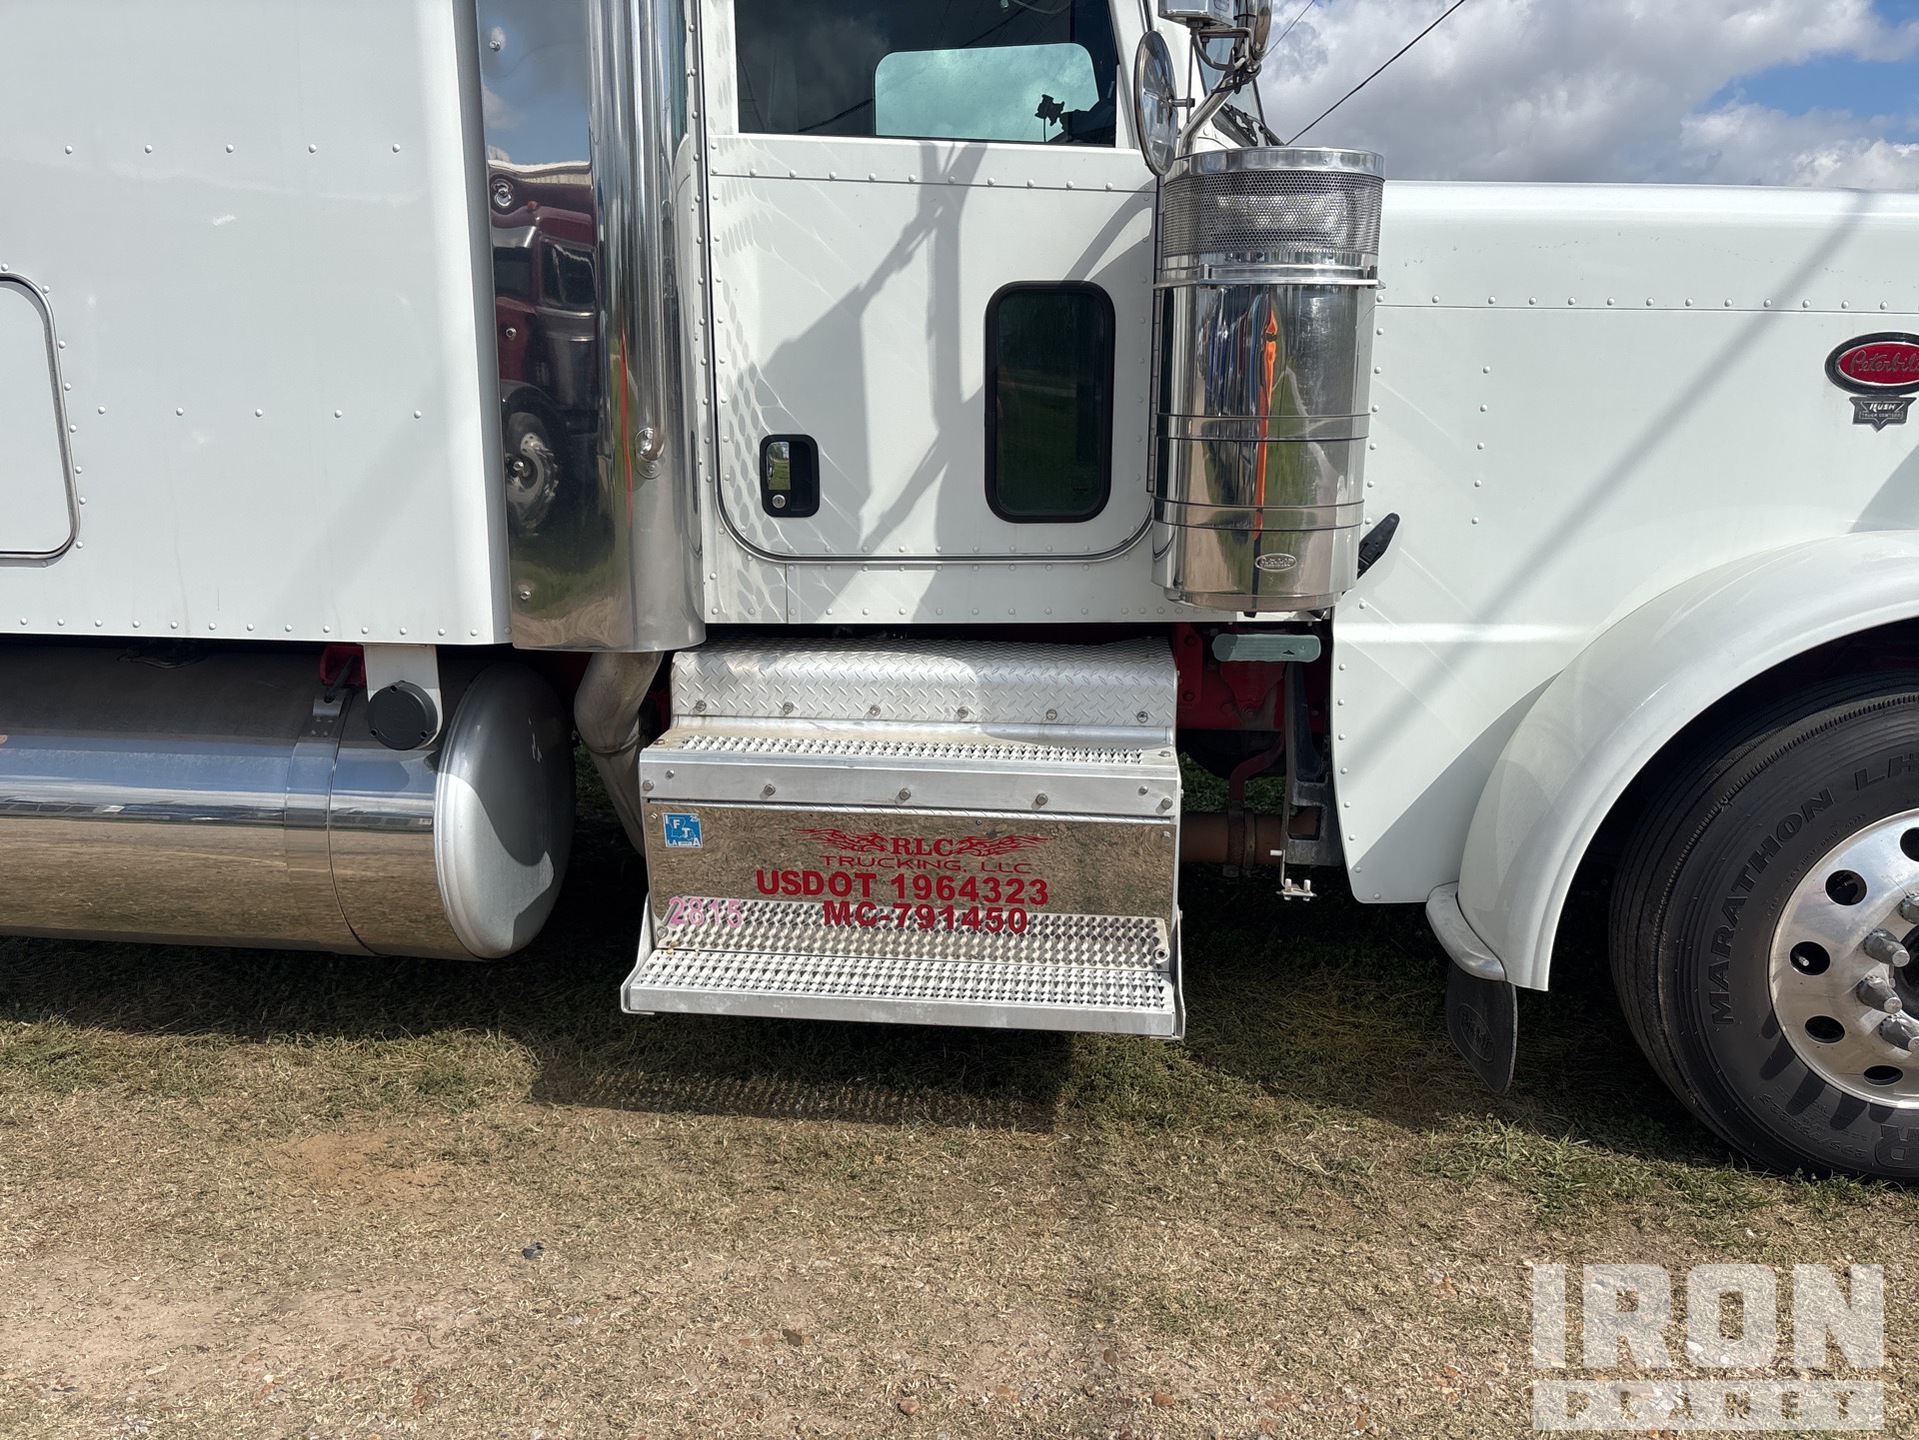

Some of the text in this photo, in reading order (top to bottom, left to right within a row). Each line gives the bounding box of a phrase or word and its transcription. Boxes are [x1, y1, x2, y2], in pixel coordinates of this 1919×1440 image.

[1869, 403, 1896, 413] RUSH
[890, 837, 954, 857] RLC
[819, 855, 1032, 874] TRUCKING, LLC
[756, 869, 1049, 906] USDOT 1964323
[664, 896, 743, 928] 2815
[822, 899, 1028, 934] MC-791450
[1710, 787, 1834, 1026] MARATHON
